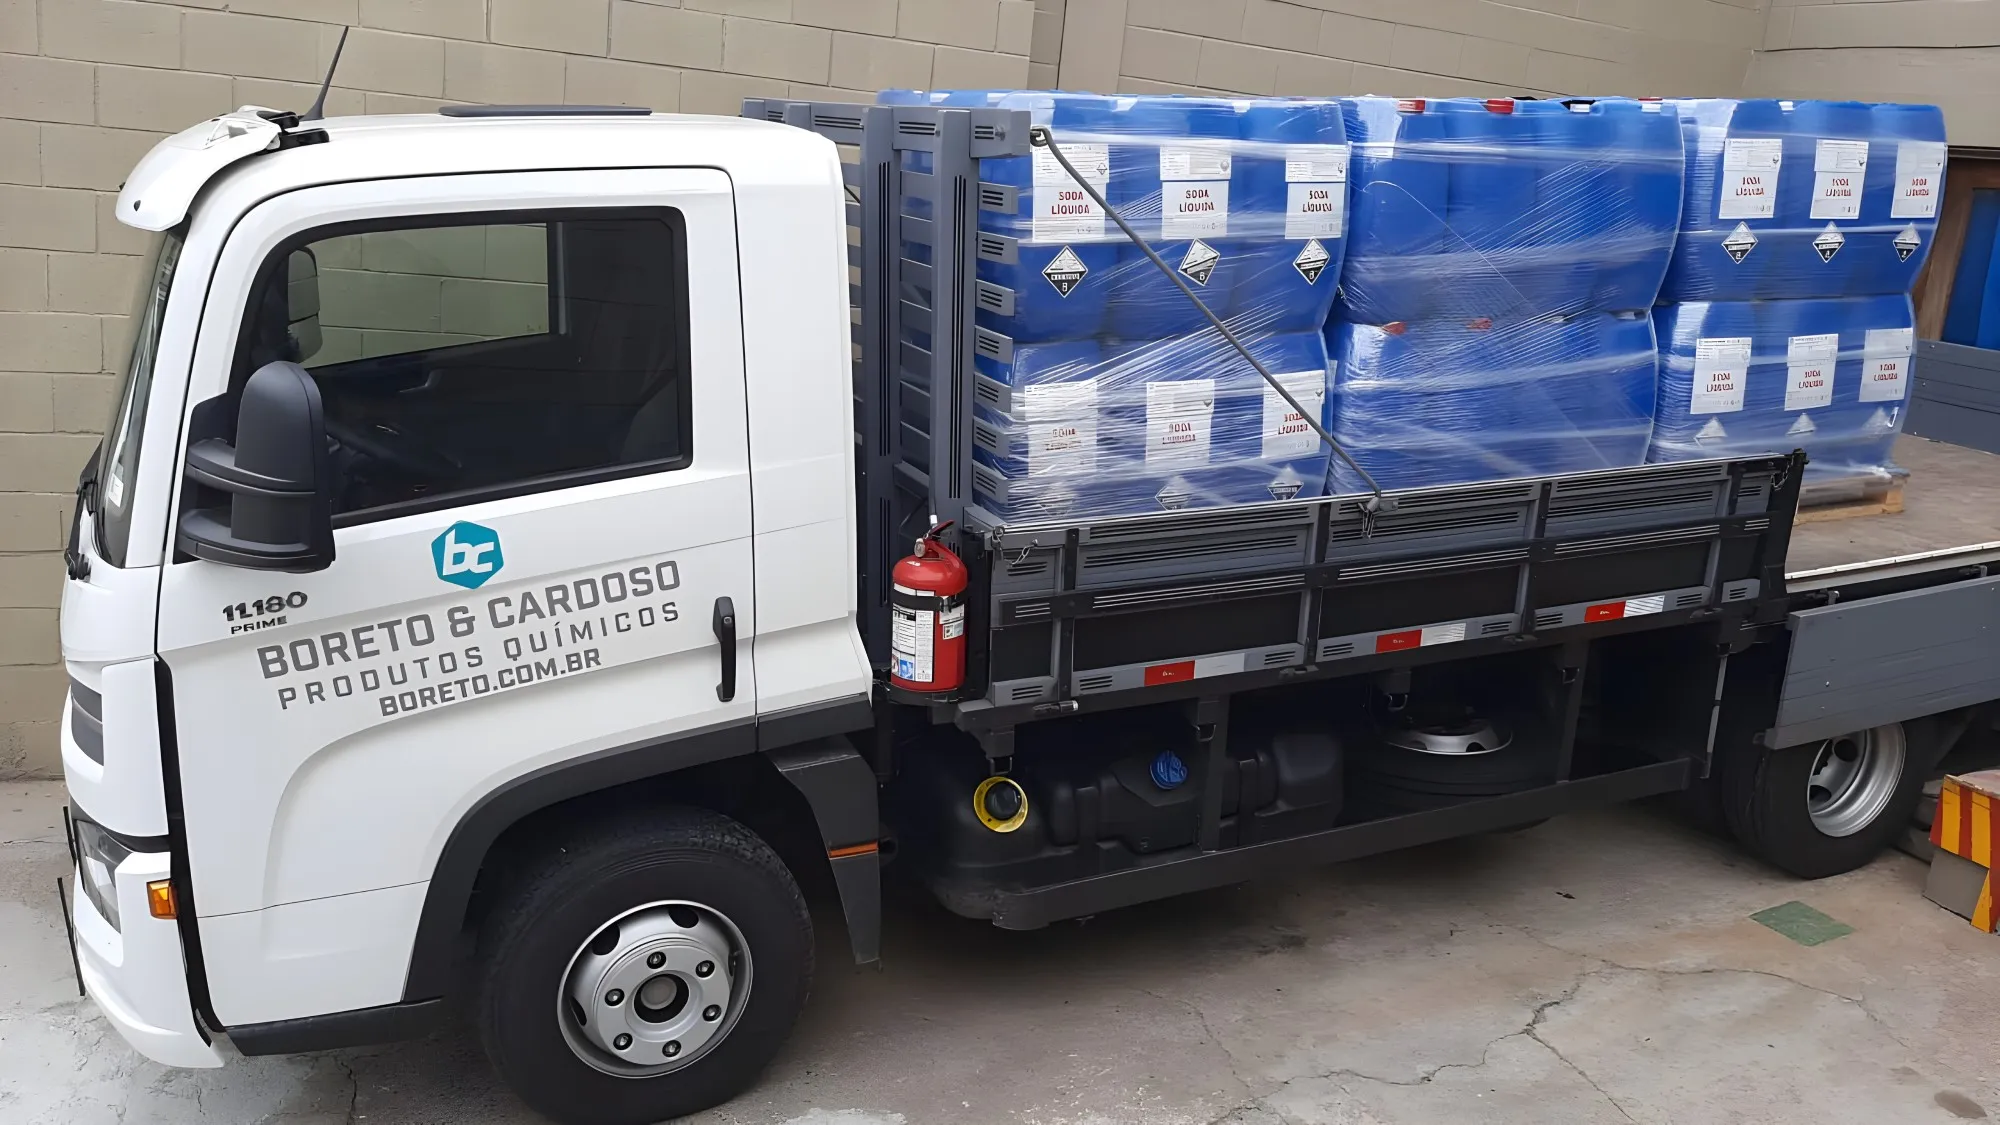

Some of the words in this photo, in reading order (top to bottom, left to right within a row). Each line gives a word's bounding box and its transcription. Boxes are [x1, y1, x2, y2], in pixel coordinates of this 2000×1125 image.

[1058, 191, 1084, 201] SODA
[443, 528, 495, 576] bc
[230, 616, 288, 634] PRIME
[257, 613, 436, 679] BORETO
[447, 605, 476, 638] &
[487, 560, 681, 629] CARDOSO
[278, 646, 483, 710] PRODUTOS
[503, 601, 679, 662] QUÍMICOS
[379, 648, 602, 717] BORETO.COM.BR
